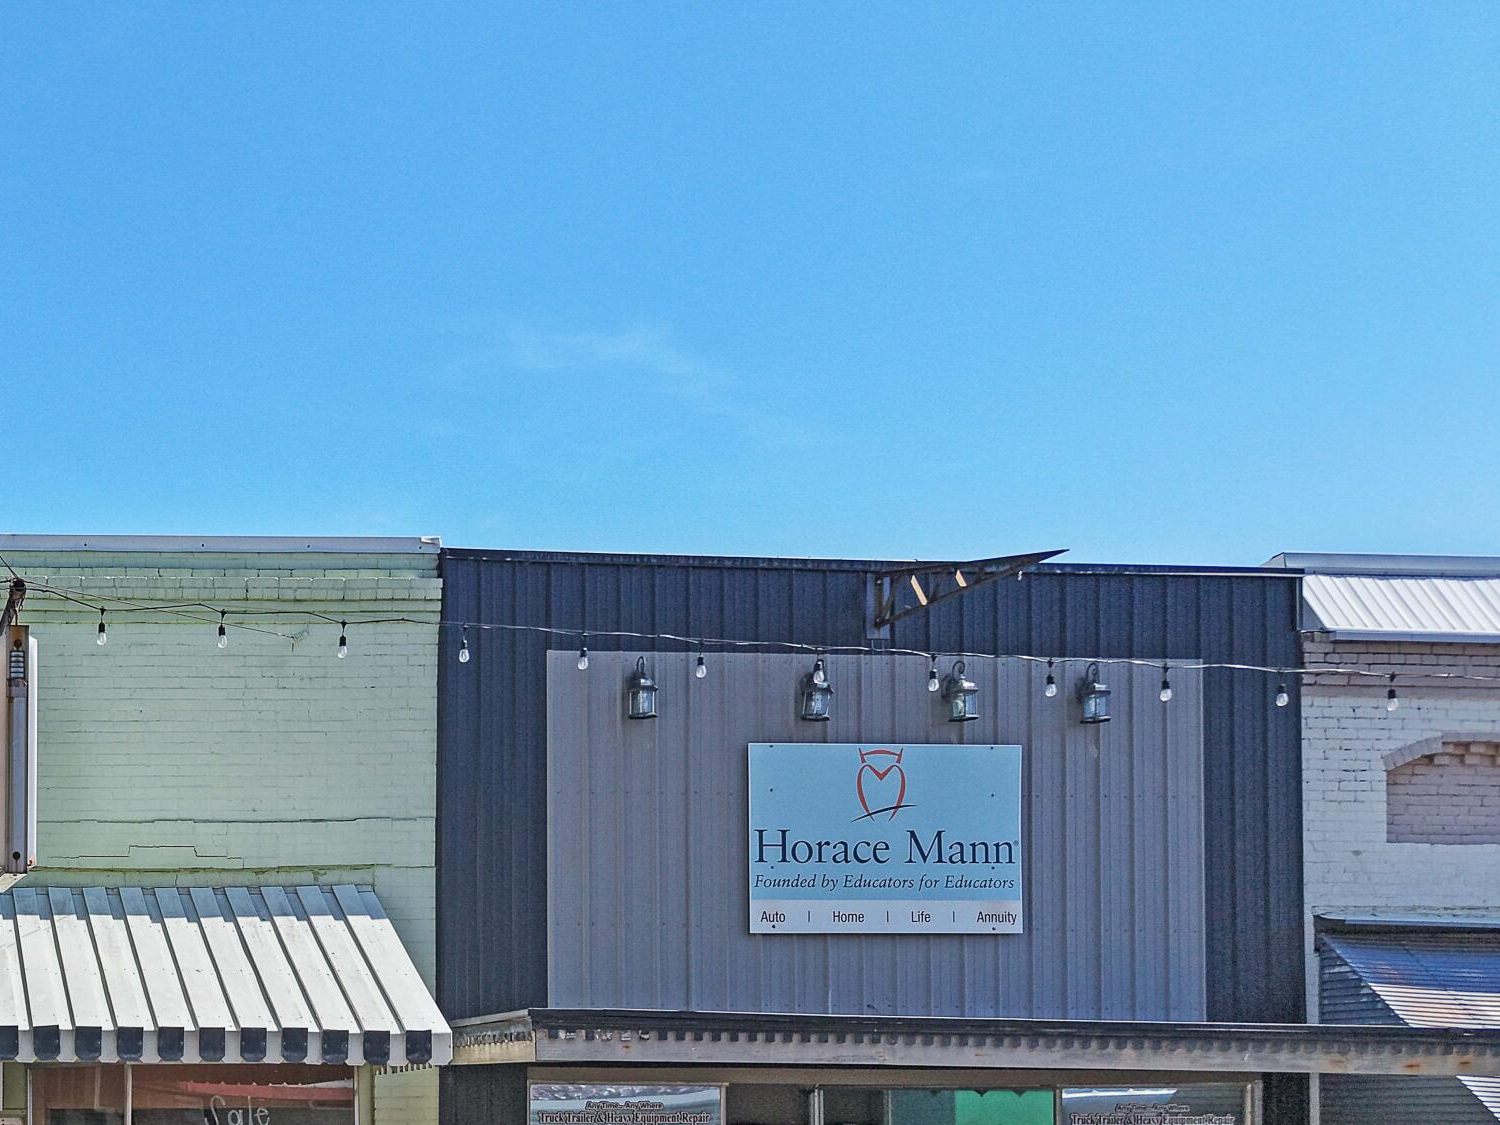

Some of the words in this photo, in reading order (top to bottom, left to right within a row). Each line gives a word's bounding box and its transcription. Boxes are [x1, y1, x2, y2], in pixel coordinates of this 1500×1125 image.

[754, 829, 890, 864] Horace
[906, 829, 1016, 865] Mann
[754, 874, 816, 889] Founded
[821, 874, 838, 892] by
[844, 874, 915, 889] Educators
[918, 874, 940, 892] for
[944, 875, 1015, 890] Educators
[760, 910, 786, 924] Auto
[832, 910, 865, 923] Home
[911, 910, 931, 923] Life
[976, 910, 1018, 925] Annuity
[585, 1101, 601, 1111] Any
[565, 1111, 596, 1124] Trailer
[595, 1112, 606, 1125] &
[606, 1111, 634, 1125] Heavy
[634, 1111, 680, 1125] Equipment
[680, 1111, 711, 1125] Repair
[1124, 1114, 1135, 1125] &
